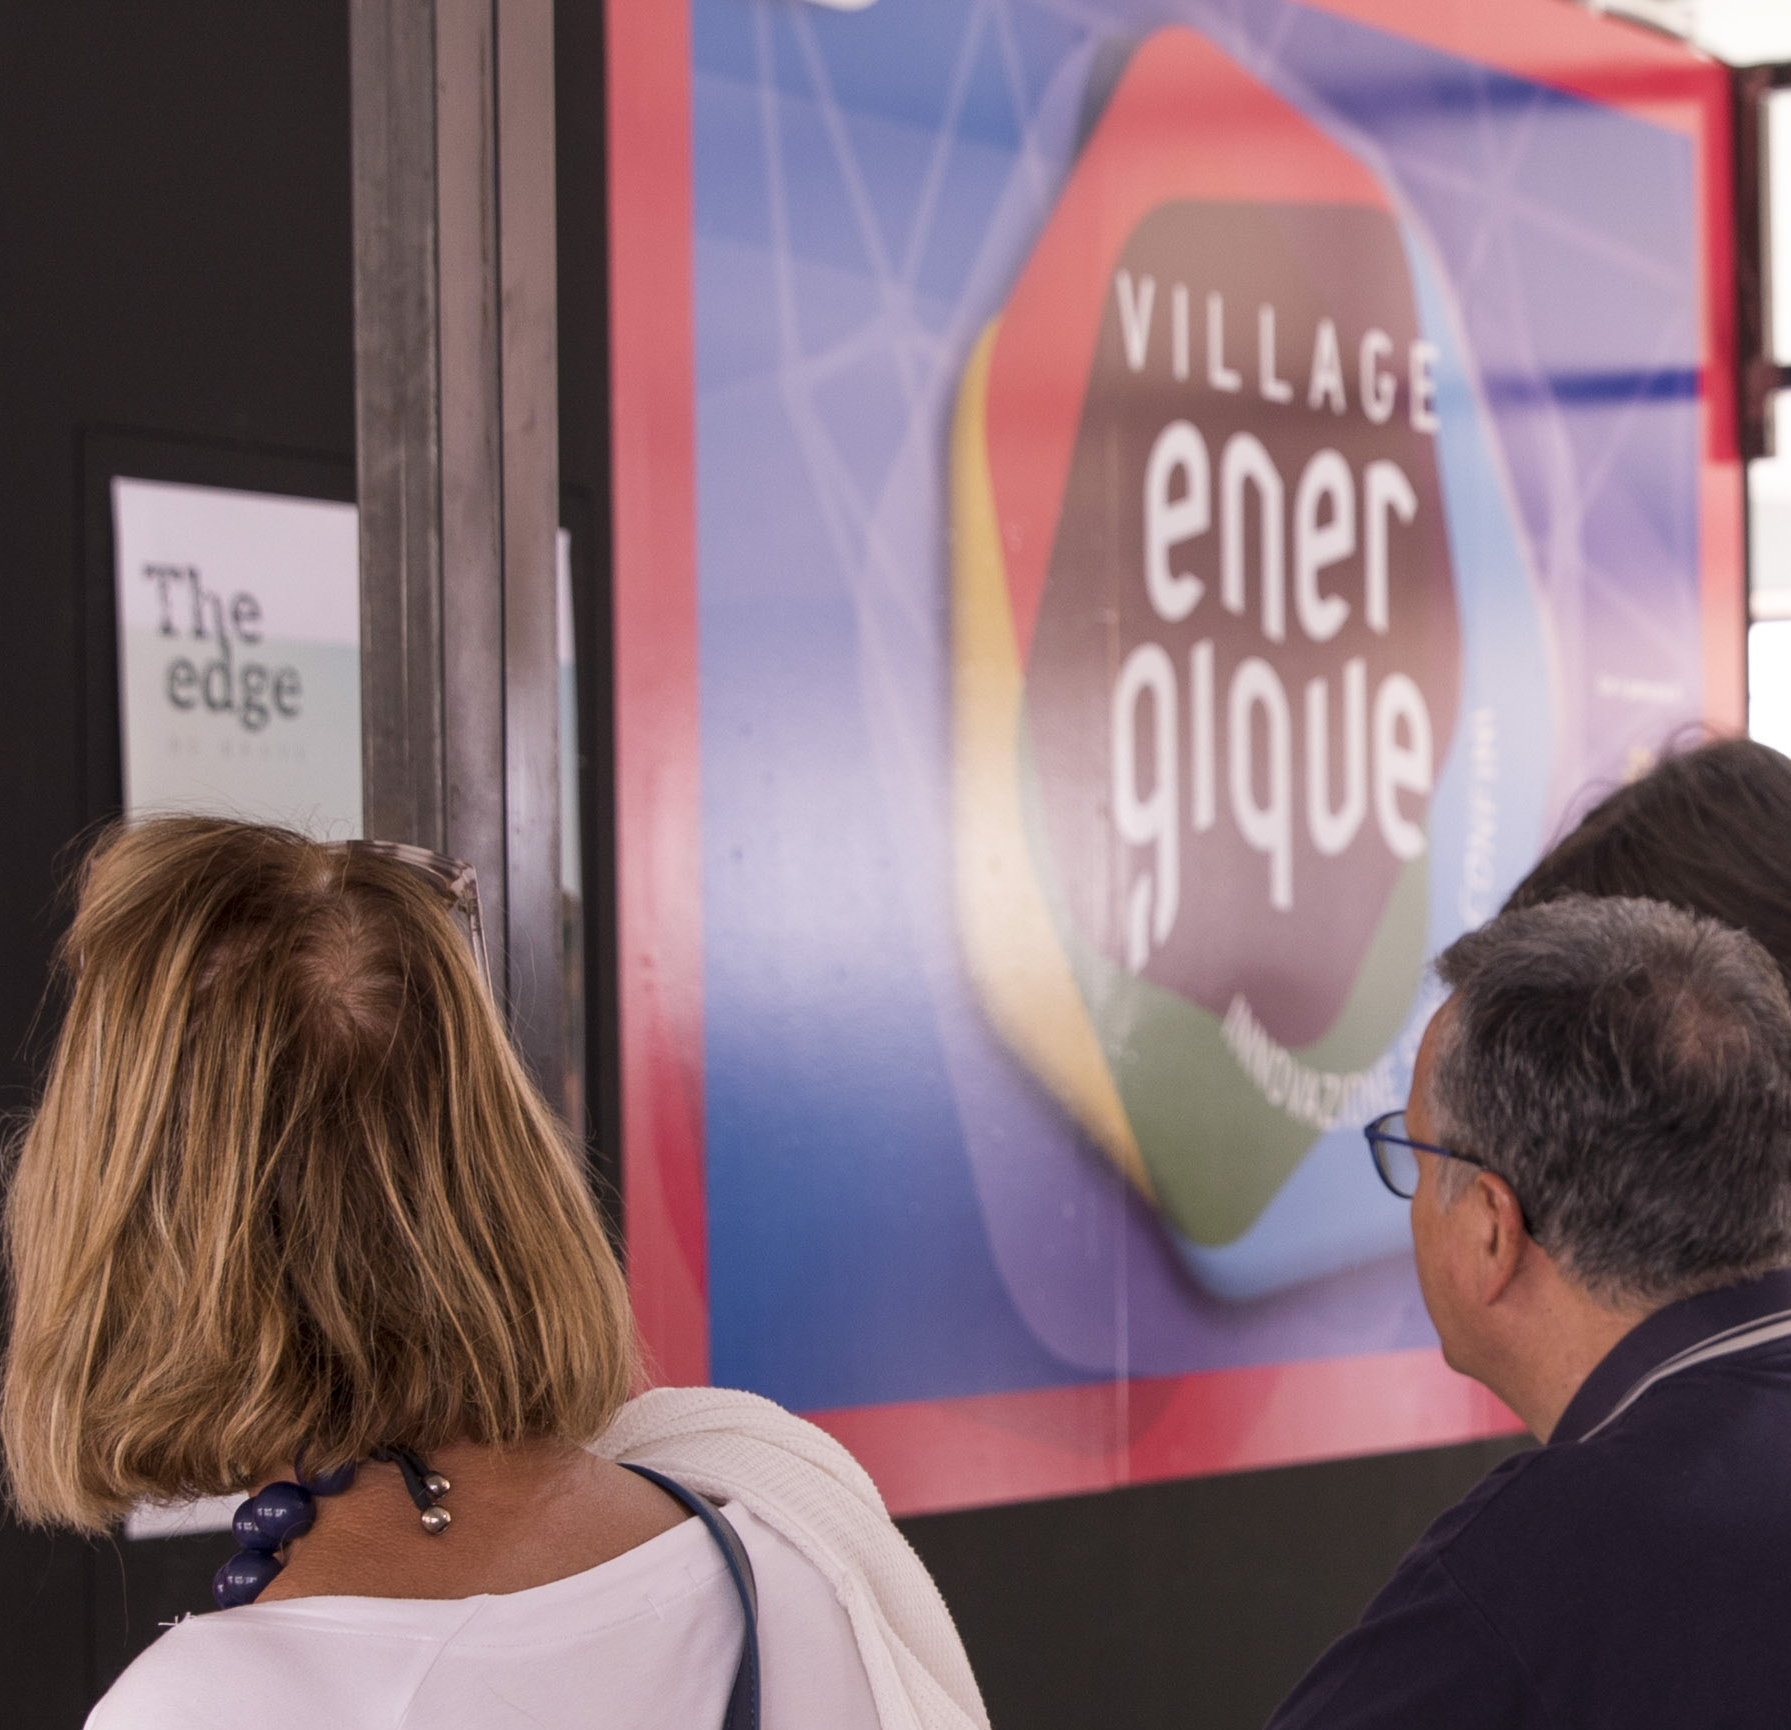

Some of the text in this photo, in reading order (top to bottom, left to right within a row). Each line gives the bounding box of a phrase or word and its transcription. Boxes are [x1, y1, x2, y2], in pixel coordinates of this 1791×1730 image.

[1115, 267, 1442, 435] VILLAGE
[141, 558, 264, 648] The
[1143, 419, 1420, 645] ener
[164, 656, 305, 734] edge
[1113, 638, 1435, 977] gique
